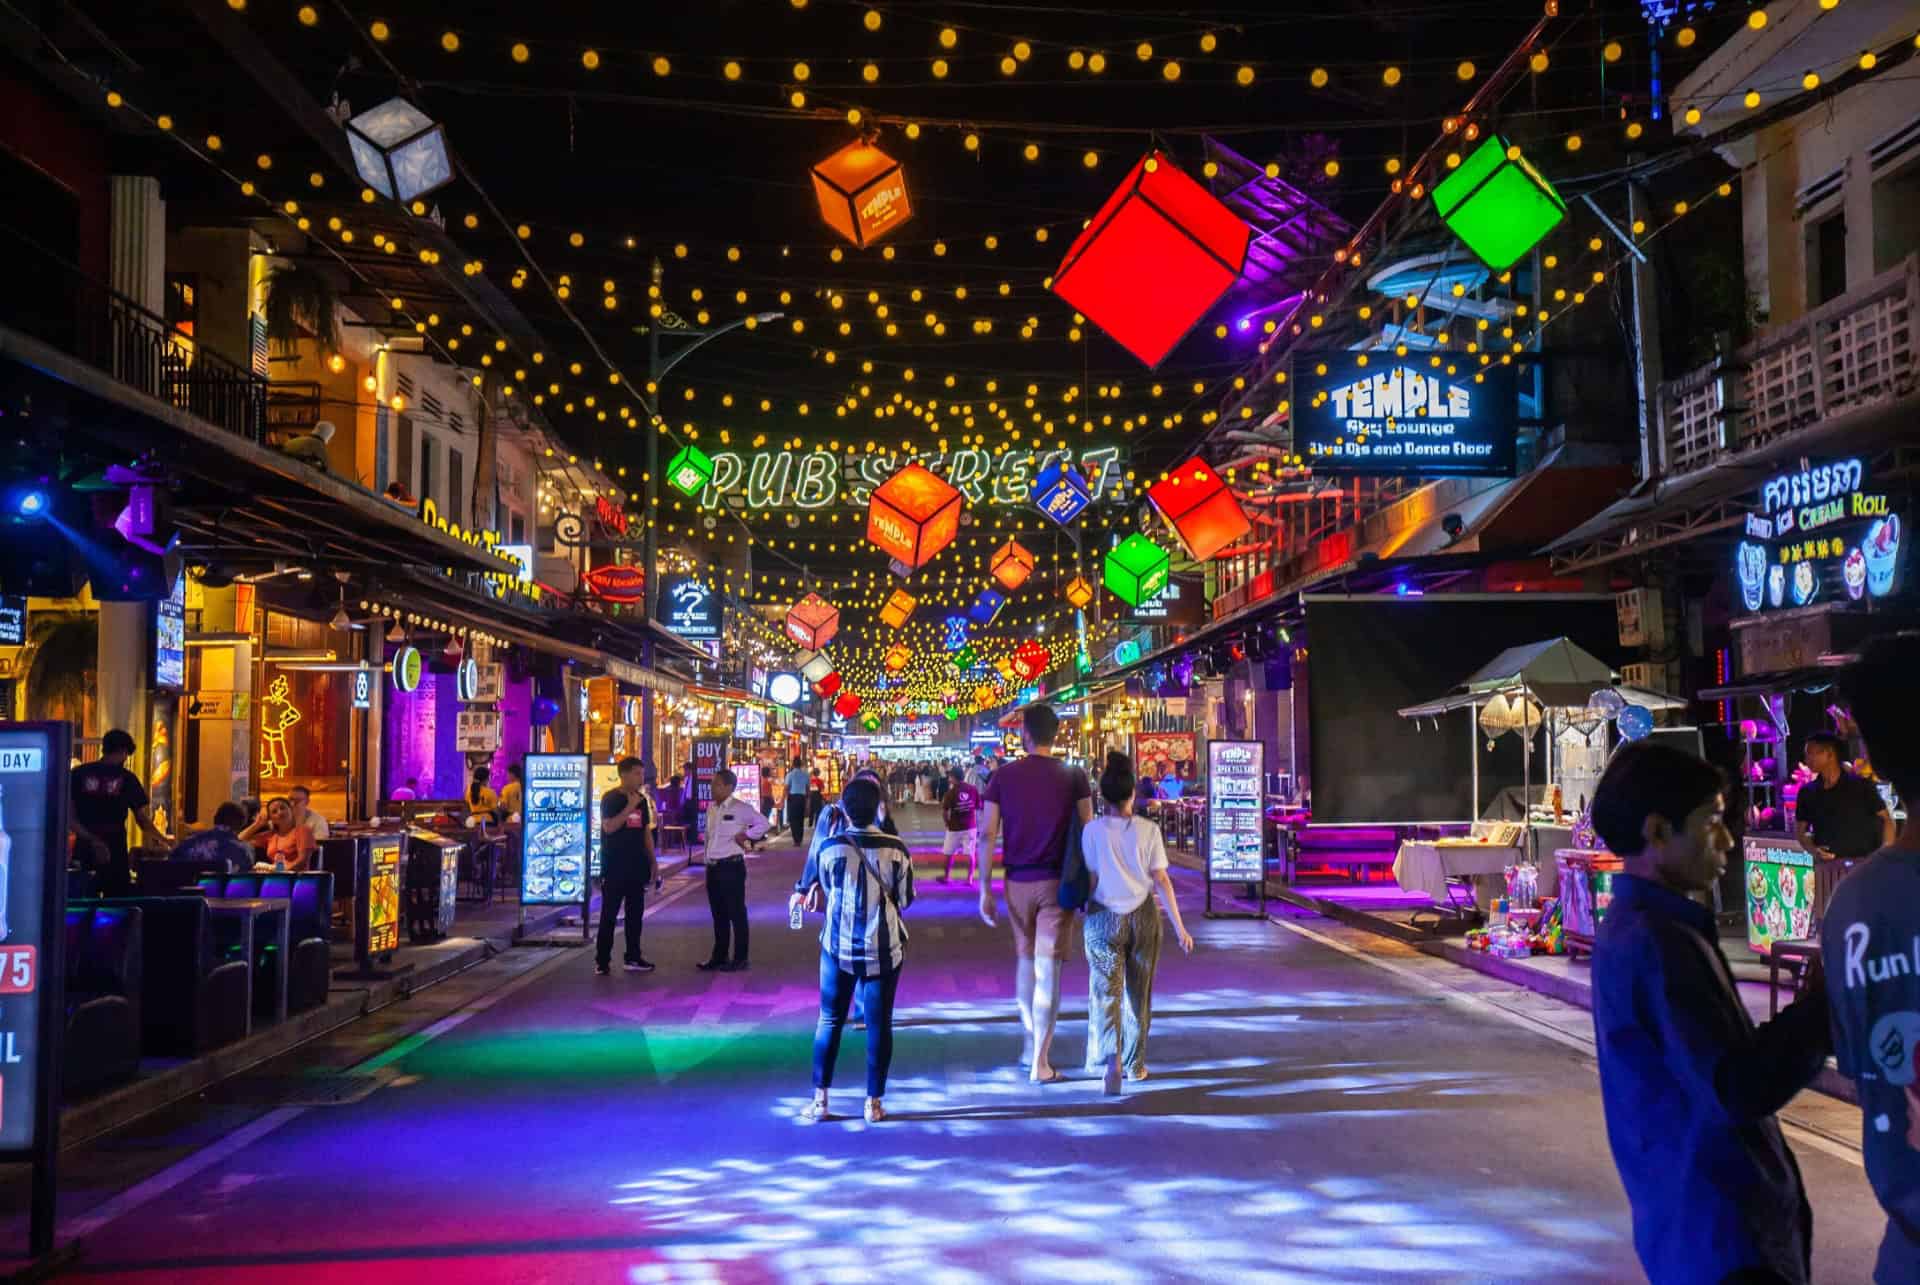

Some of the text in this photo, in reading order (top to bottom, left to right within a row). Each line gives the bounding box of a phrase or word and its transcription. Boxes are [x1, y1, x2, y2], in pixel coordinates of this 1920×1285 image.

[1331, 366, 1470, 418] TEMPLE
[1386, 419, 1455, 436] Lounge
[1373, 442, 1401, 455] and
[1405, 442, 1450, 455] Dance
[1453, 442, 1492, 455] Floor
[702, 450, 838, 509] PUB
[1799, 498, 1845, 531] CREAM
[1852, 493, 1889, 516] ROLL
[697, 743, 721, 757] BUY
[3, 753, 31, 769] DAY
